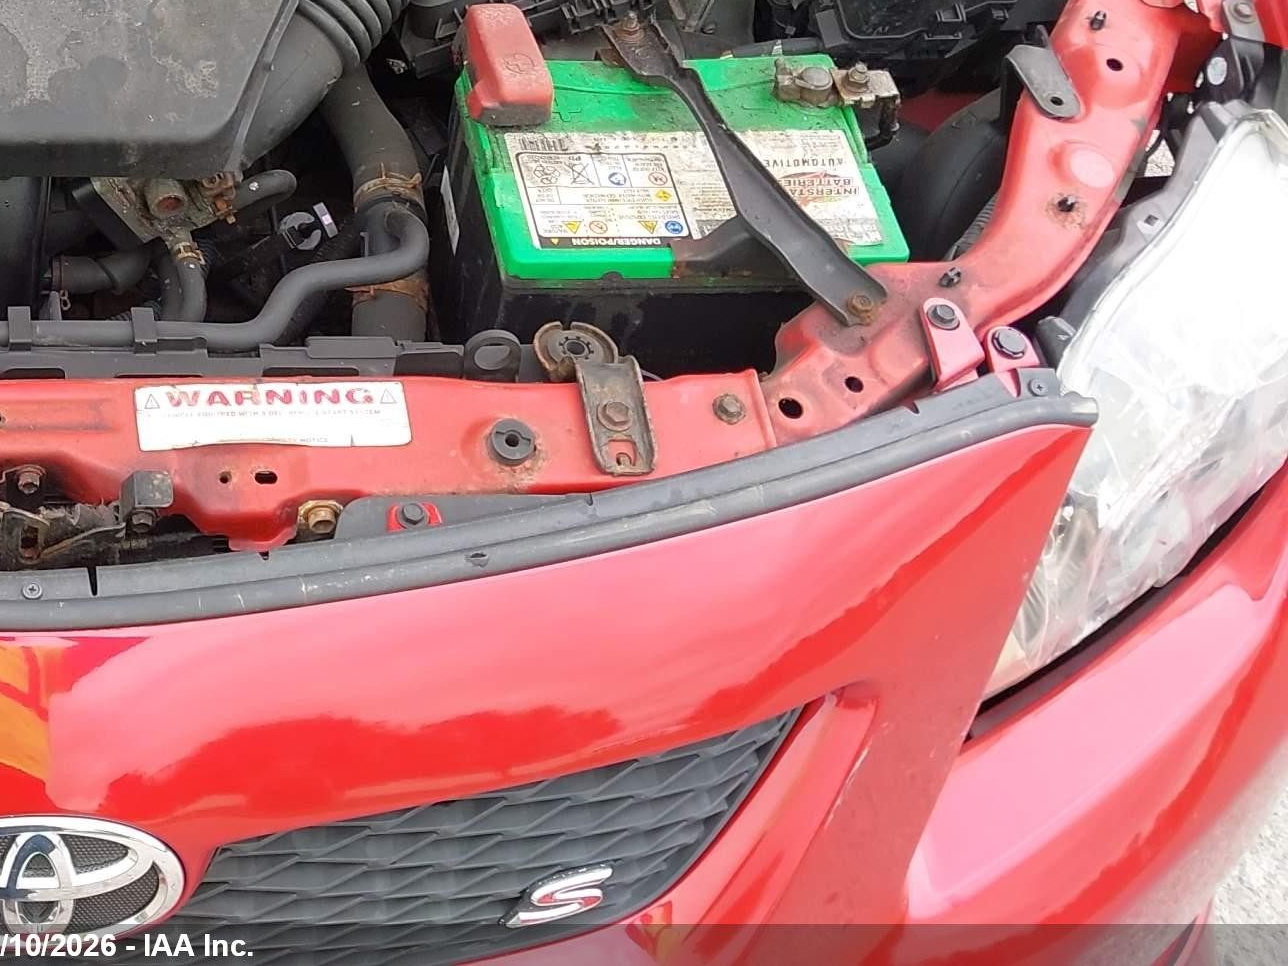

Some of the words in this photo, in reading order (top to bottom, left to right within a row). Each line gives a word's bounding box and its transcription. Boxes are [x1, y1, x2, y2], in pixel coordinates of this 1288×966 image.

[762, 158, 844, 168] AUTOMOTIVE
[571, 237, 662, 246] DANGER/POISON
[165, 388, 375, 408] WARNING
[506, 866, 614, 929] S
